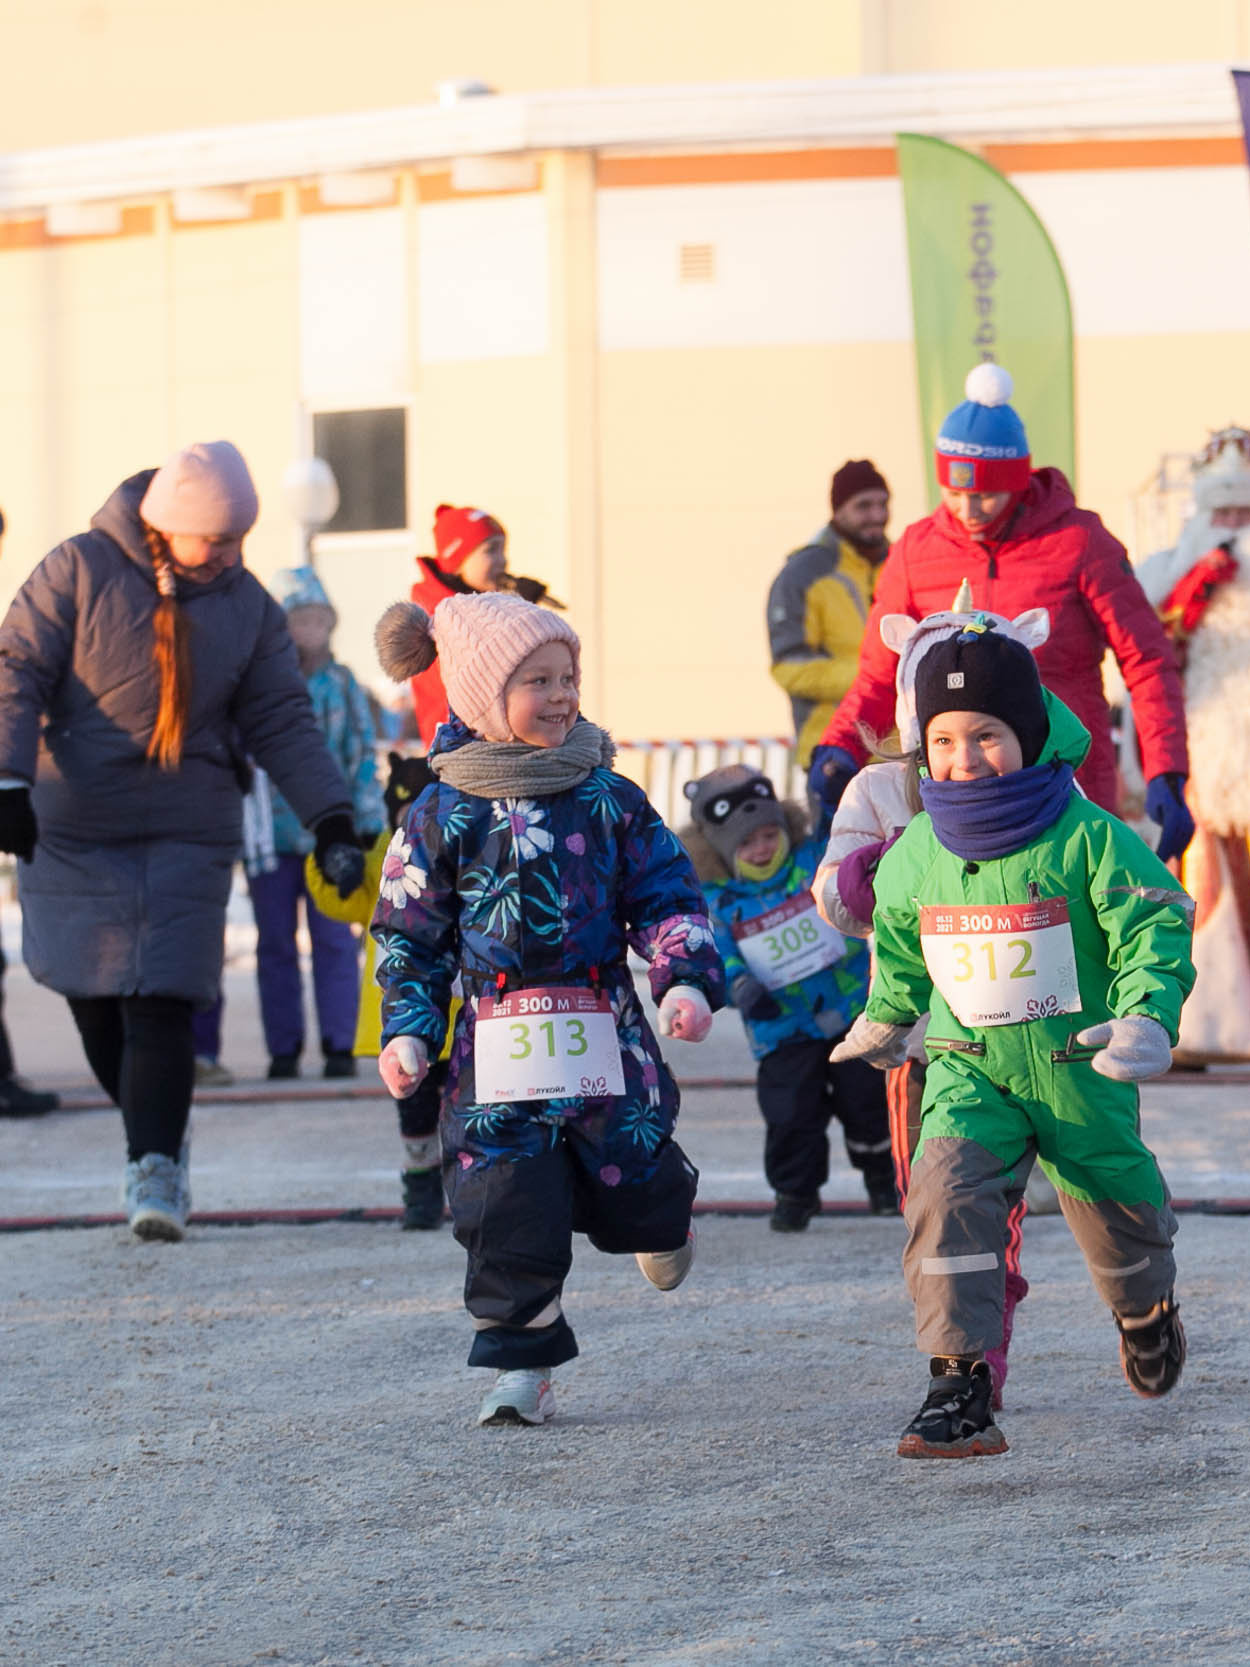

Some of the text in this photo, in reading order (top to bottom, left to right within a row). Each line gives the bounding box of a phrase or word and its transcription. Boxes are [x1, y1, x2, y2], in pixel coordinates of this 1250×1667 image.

[936, 923, 953, 932] 2021
[960, 915, 993, 932] 300
[762, 918, 819, 961] 308
[953, 939, 1037, 983] 312
[518, 996, 553, 1014] 300
[977, 1011, 1011, 1021] ЛУКОЙЛ
[509, 1019, 589, 1060] 313
[535, 1086, 566, 1095] ЛУКОЙЛ
